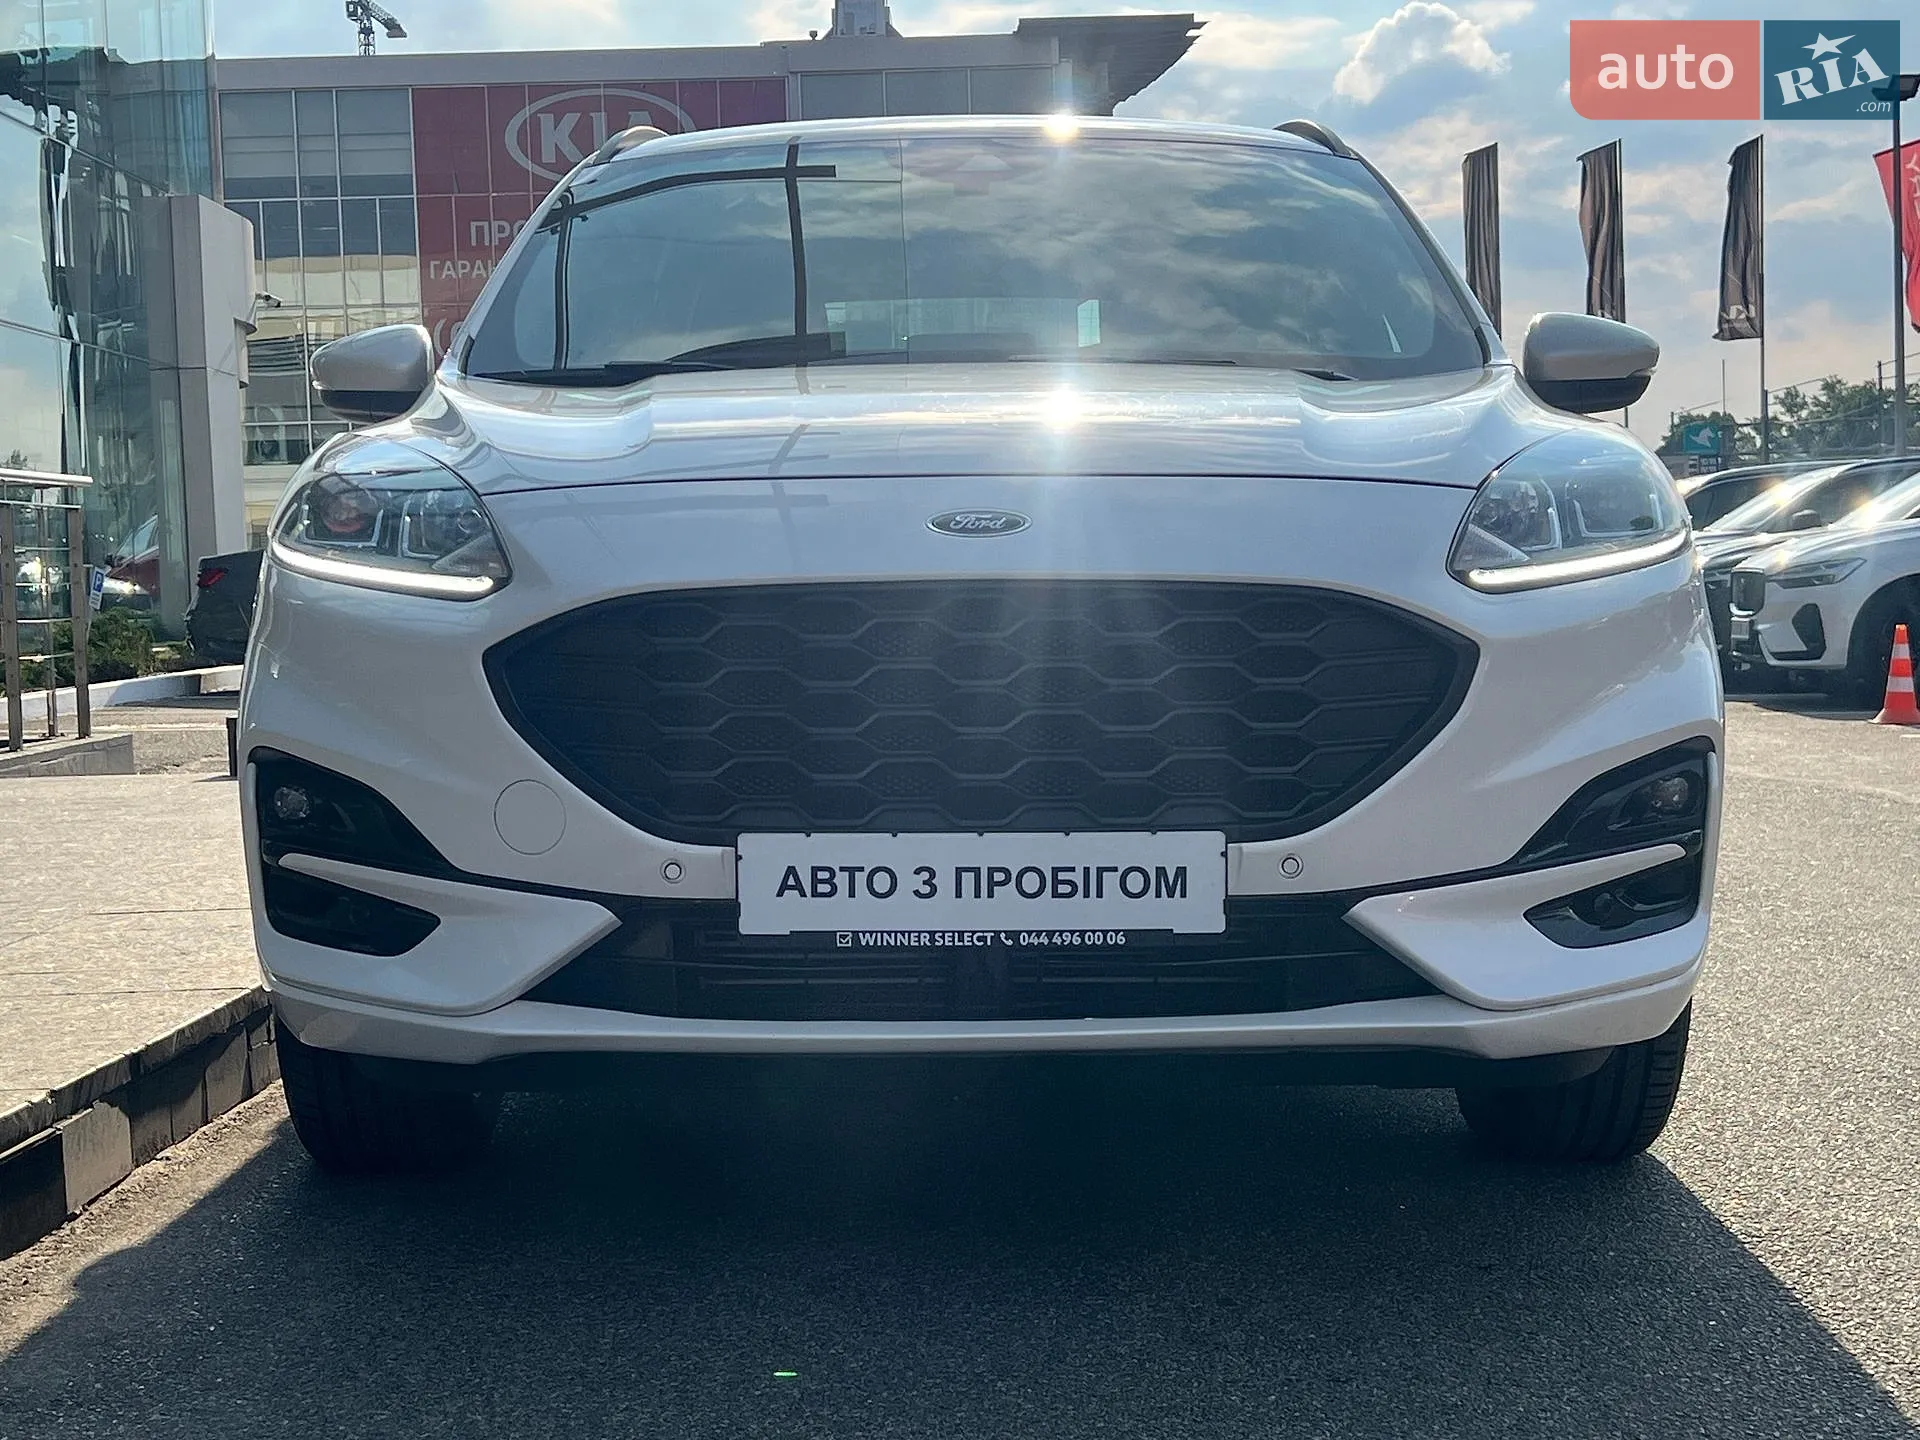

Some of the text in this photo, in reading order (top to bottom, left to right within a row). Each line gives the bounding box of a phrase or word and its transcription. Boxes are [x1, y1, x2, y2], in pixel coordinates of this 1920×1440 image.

[950, 514, 1007, 529] Ford
[776, 866, 1187, 899] АВТО З ПРОБІГОМ
[858, 932, 1126, 946] WINNER SELECT 044 496 00 06
